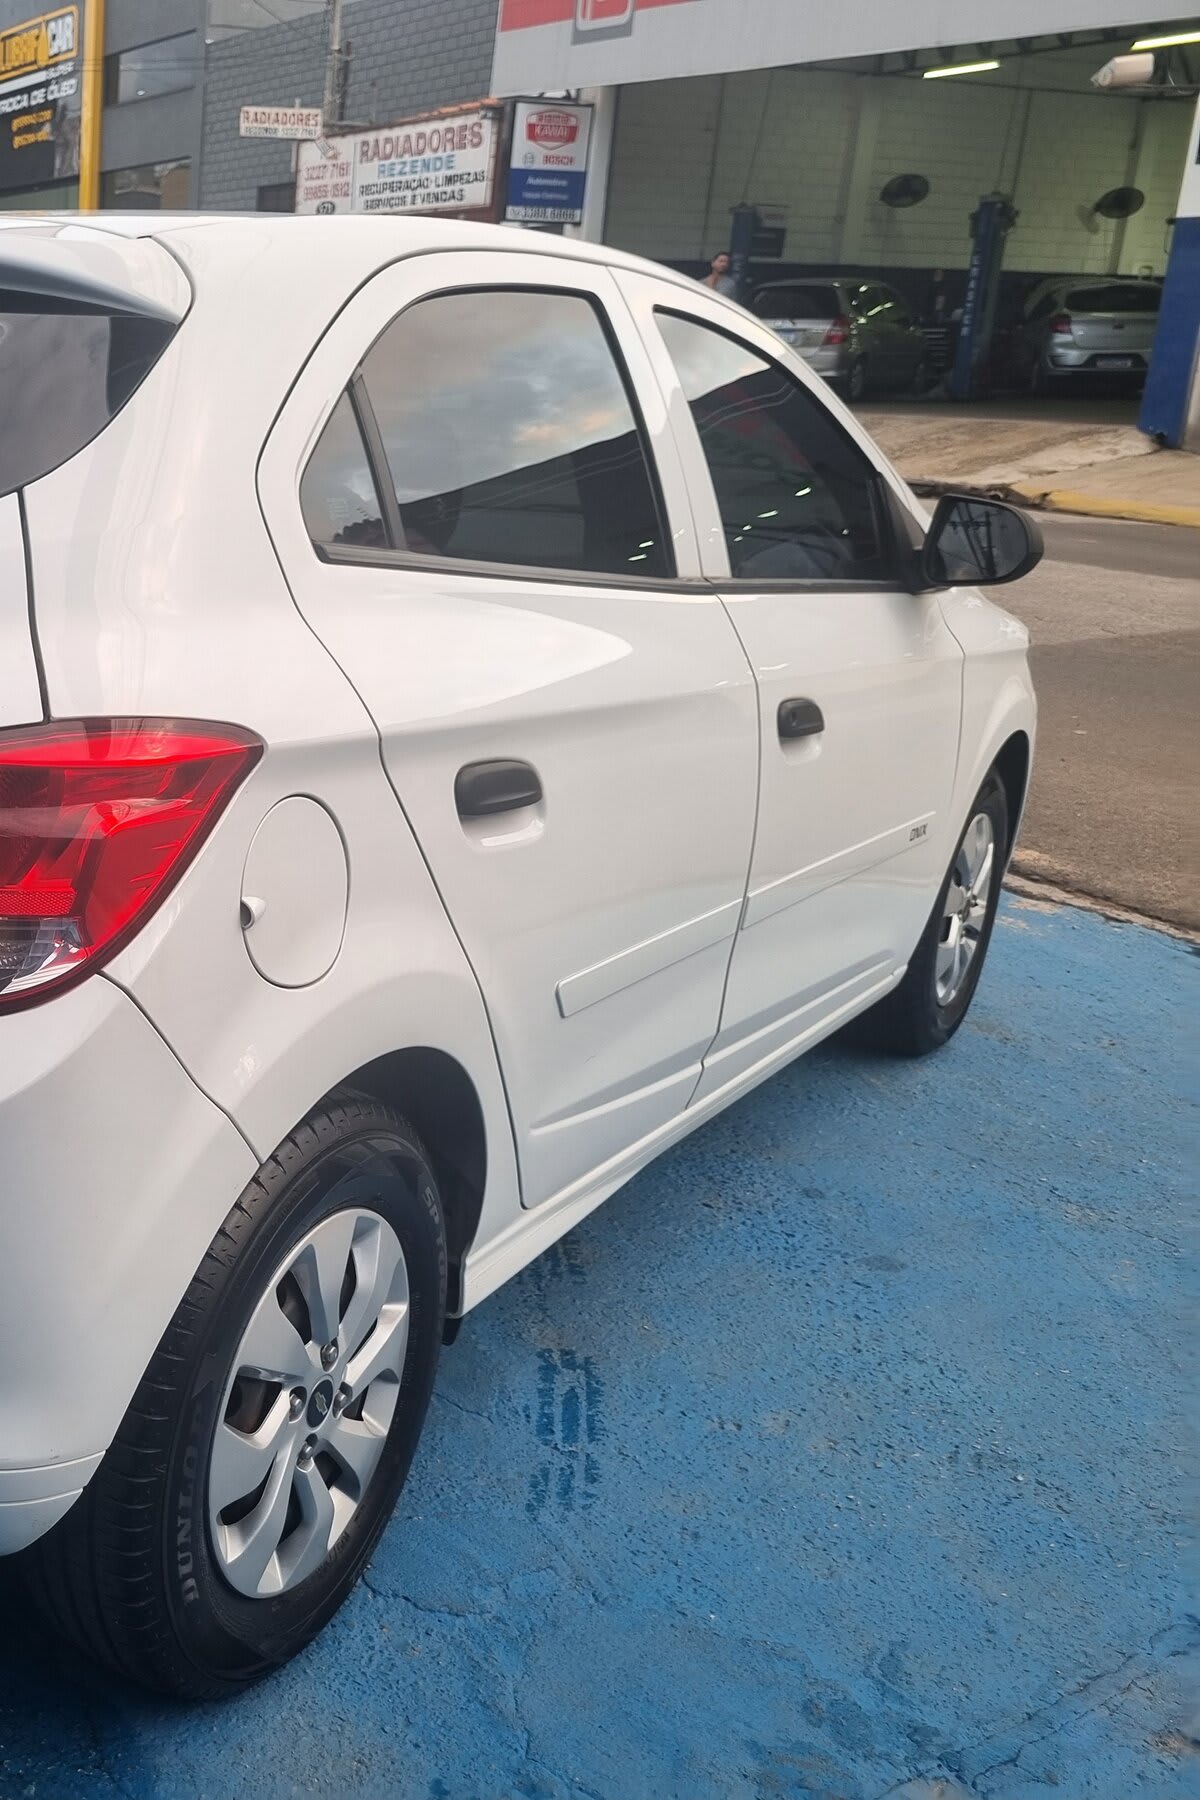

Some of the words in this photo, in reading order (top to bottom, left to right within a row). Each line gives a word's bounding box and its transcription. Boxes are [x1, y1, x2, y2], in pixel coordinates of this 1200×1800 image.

[30, 88, 46, 105] DE
[243, 110, 319, 127] RADIADORES
[359, 122, 483, 164] RADIADORES
[377, 154, 456, 178] REZENDE
[435, 170, 486, 188] LIMPEZAS
